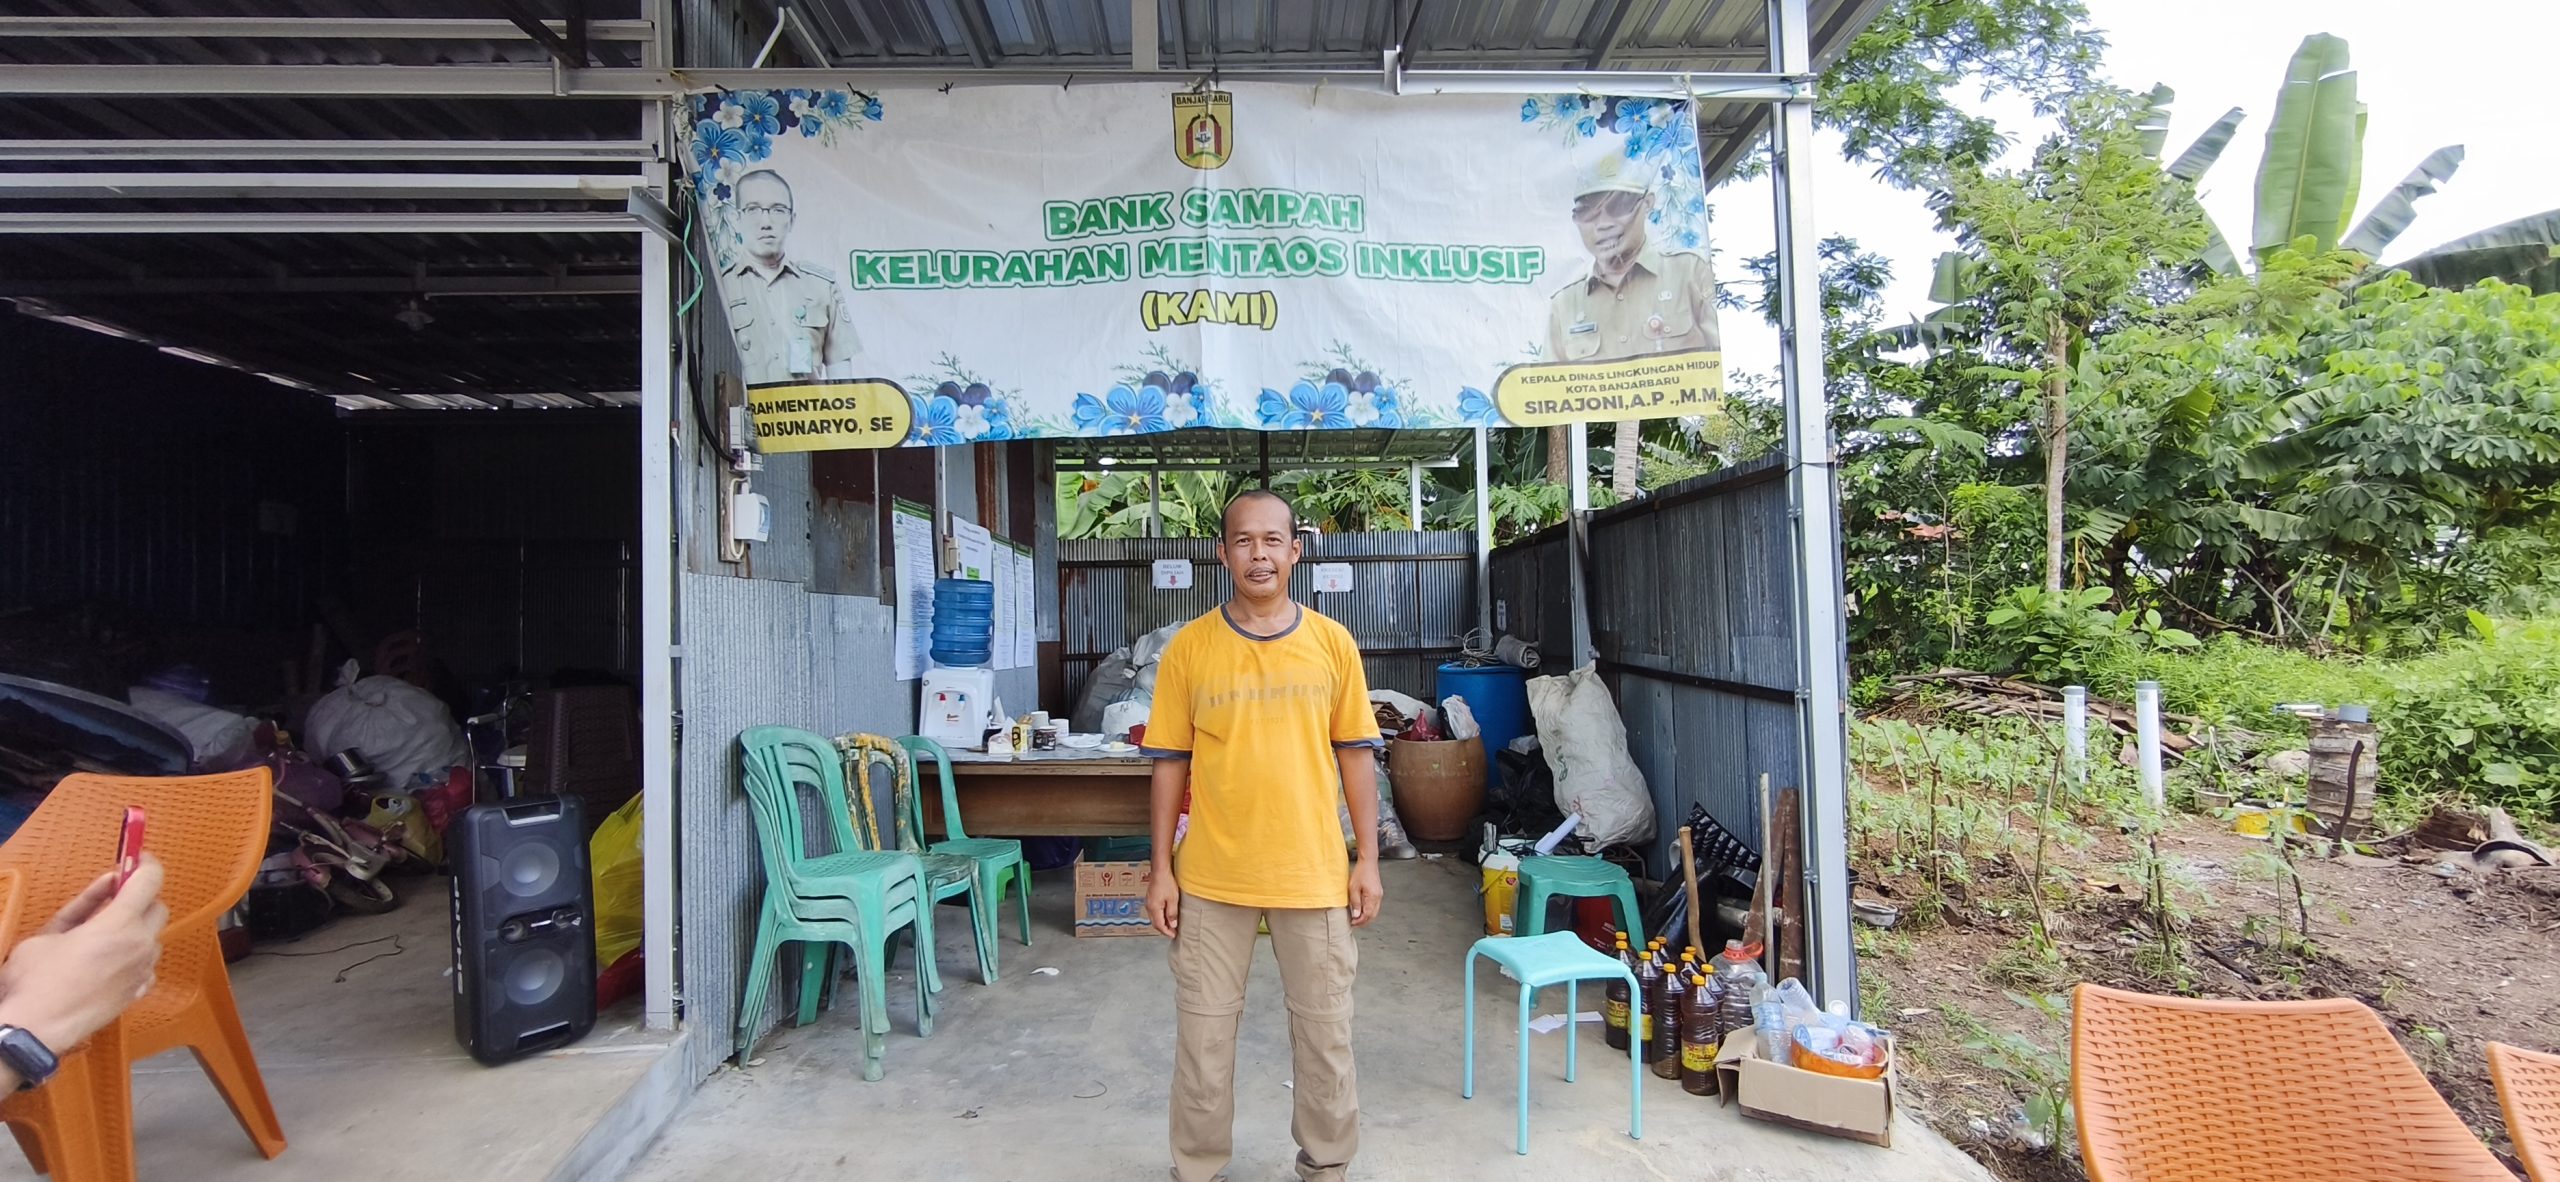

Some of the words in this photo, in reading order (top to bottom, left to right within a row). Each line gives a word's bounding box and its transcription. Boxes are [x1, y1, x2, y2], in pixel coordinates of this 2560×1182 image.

[1044, 192, 1173, 241] BANK
[1182, 188, 1365, 232] SAMPAH
[850, 243, 1129, 289] KELURAHAN
[1143, 237, 1348, 279] MENTAOS
[1355, 243, 1546, 284] INKLUSIF
[1141, 289, 1278, 331] (KAMI)
[1521, 374, 1567, 384] KEPALA
[1569, 372, 1605, 382] DINAS
[1606, 363, 1685, 379] LINGKUNGAN
[1686, 360, 1720, 371] HIDUP
[1565, 384, 1598, 394] KOTA
[1599, 376, 1681, 392] BANJARBARU
[776, 397, 856, 413] MENTAOS
[777, 418, 863, 437] SUNARYO,
[870, 416, 893, 432] SE
[454, 876, 463, 994] SHARP
